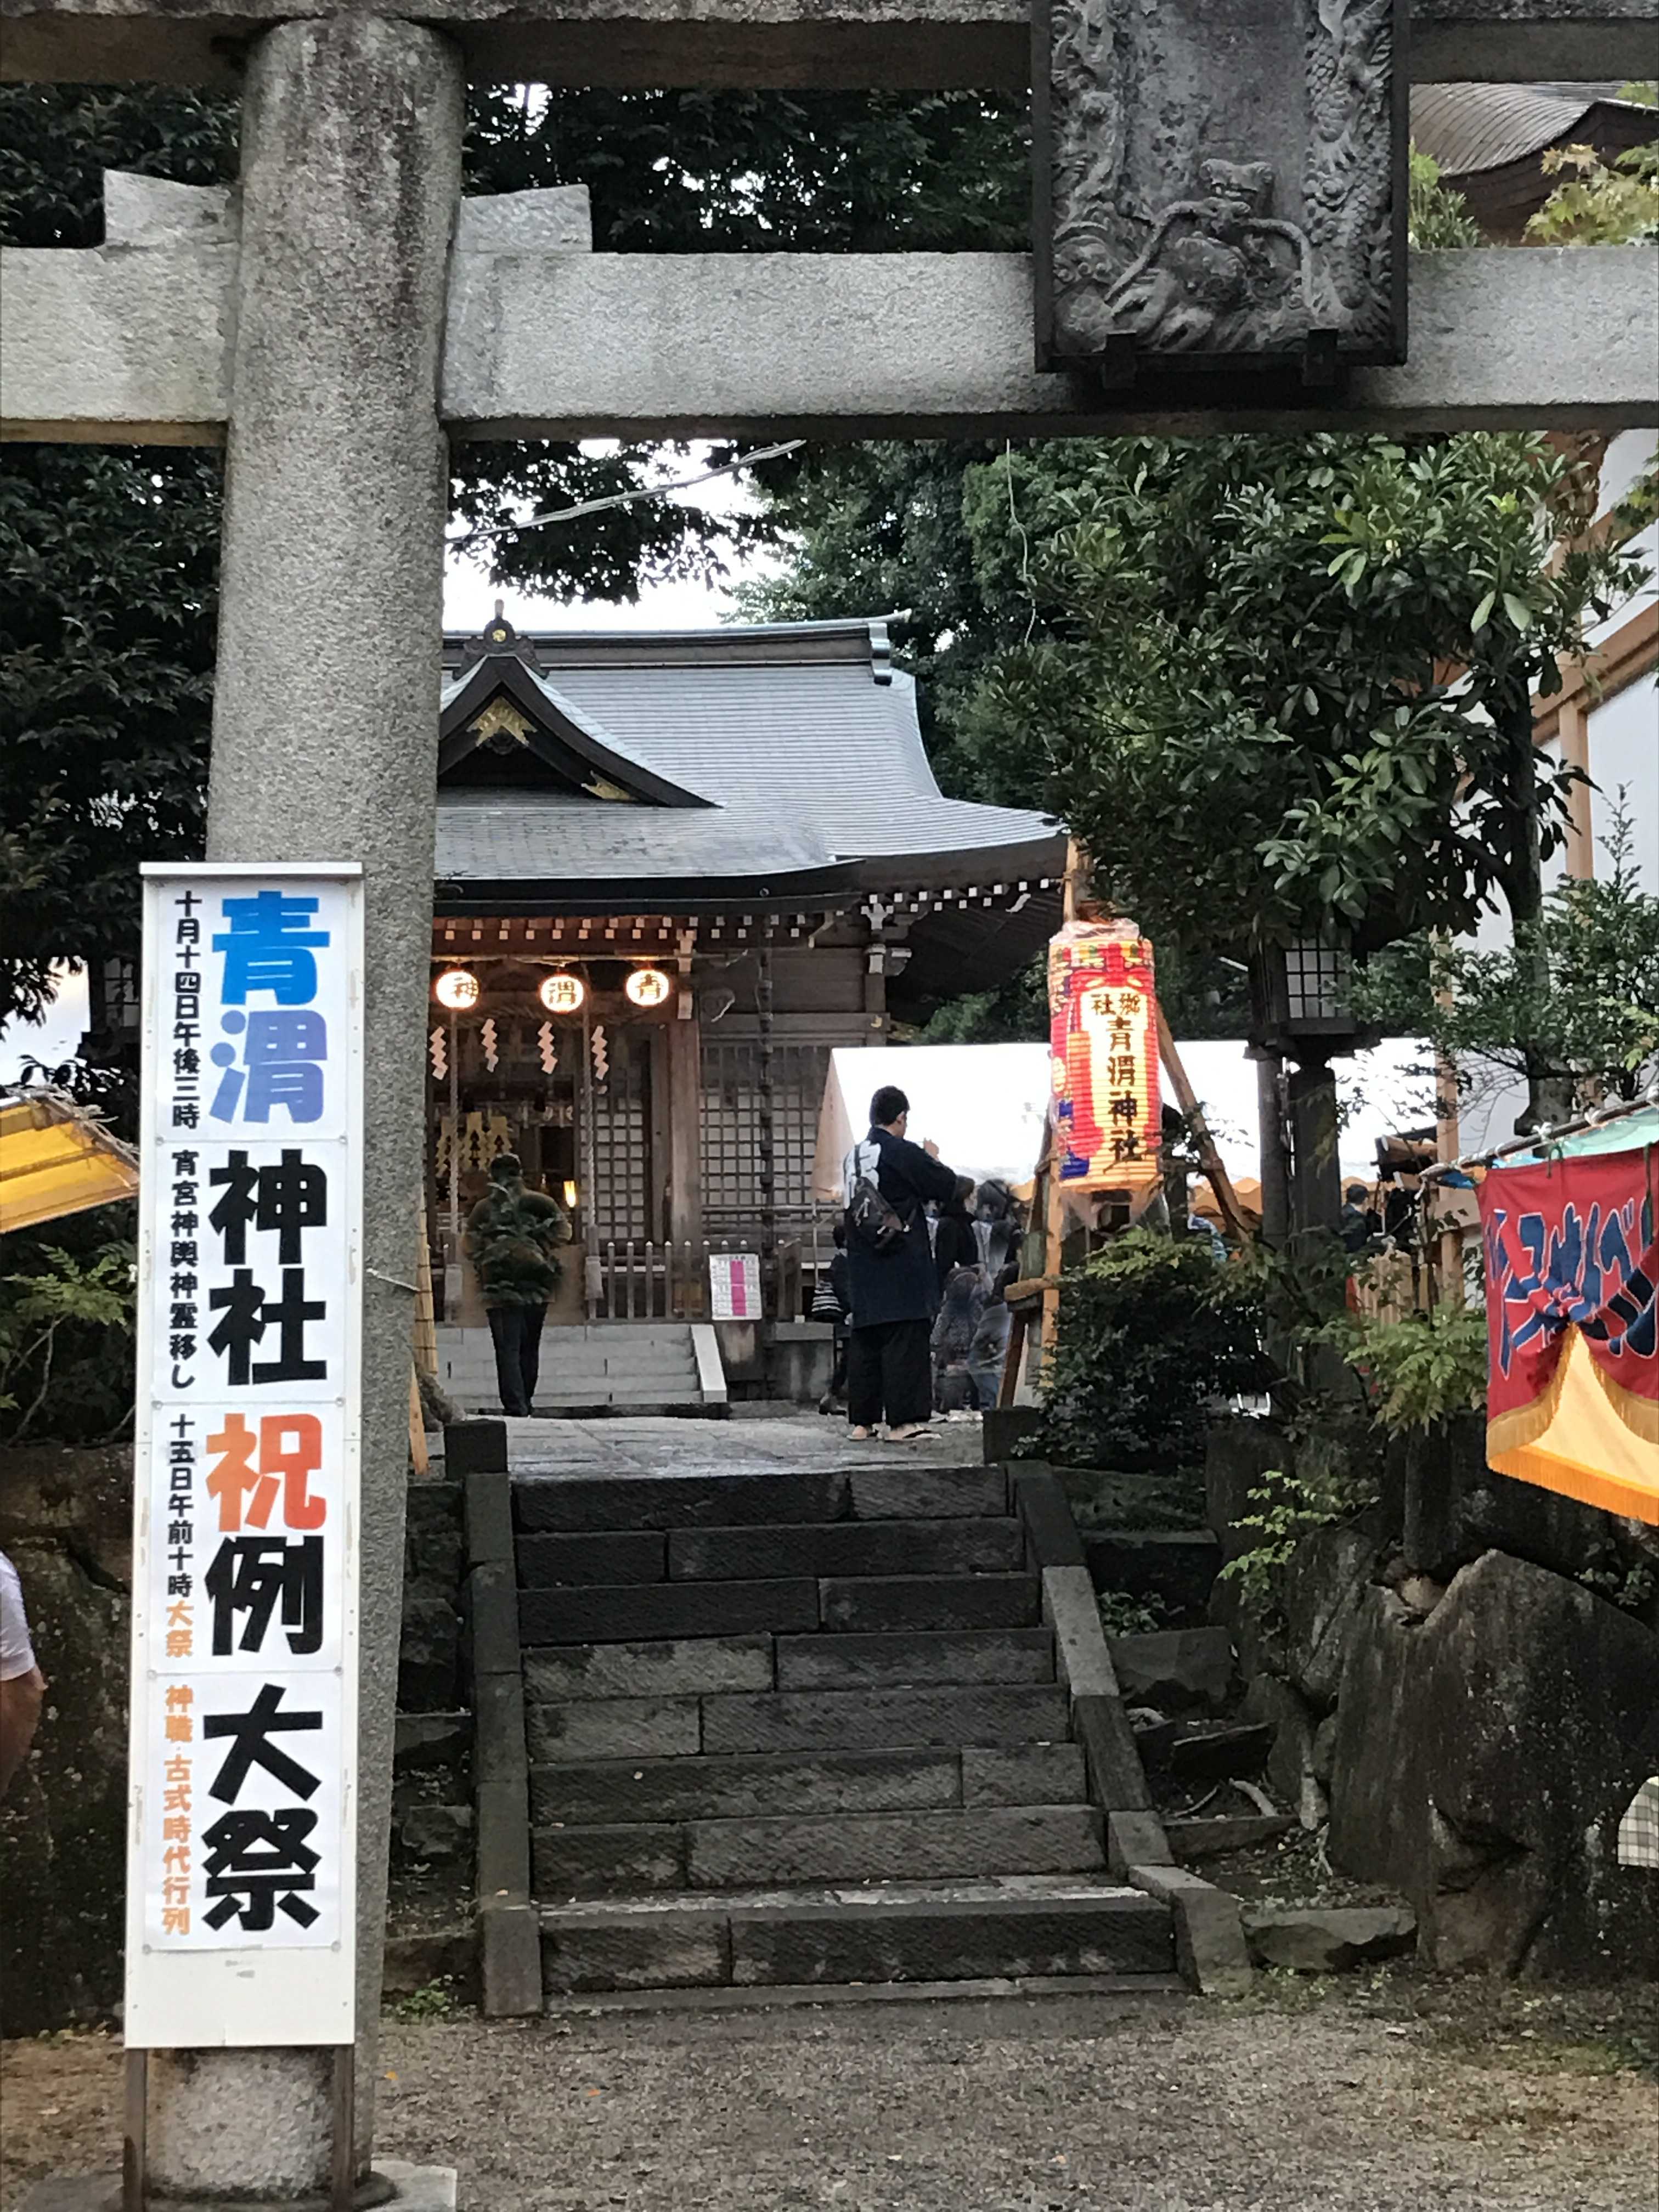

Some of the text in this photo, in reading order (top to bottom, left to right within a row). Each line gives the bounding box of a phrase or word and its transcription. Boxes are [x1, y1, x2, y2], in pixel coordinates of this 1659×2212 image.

[173, 890, 202, 1129] 十月十四日午後三時
